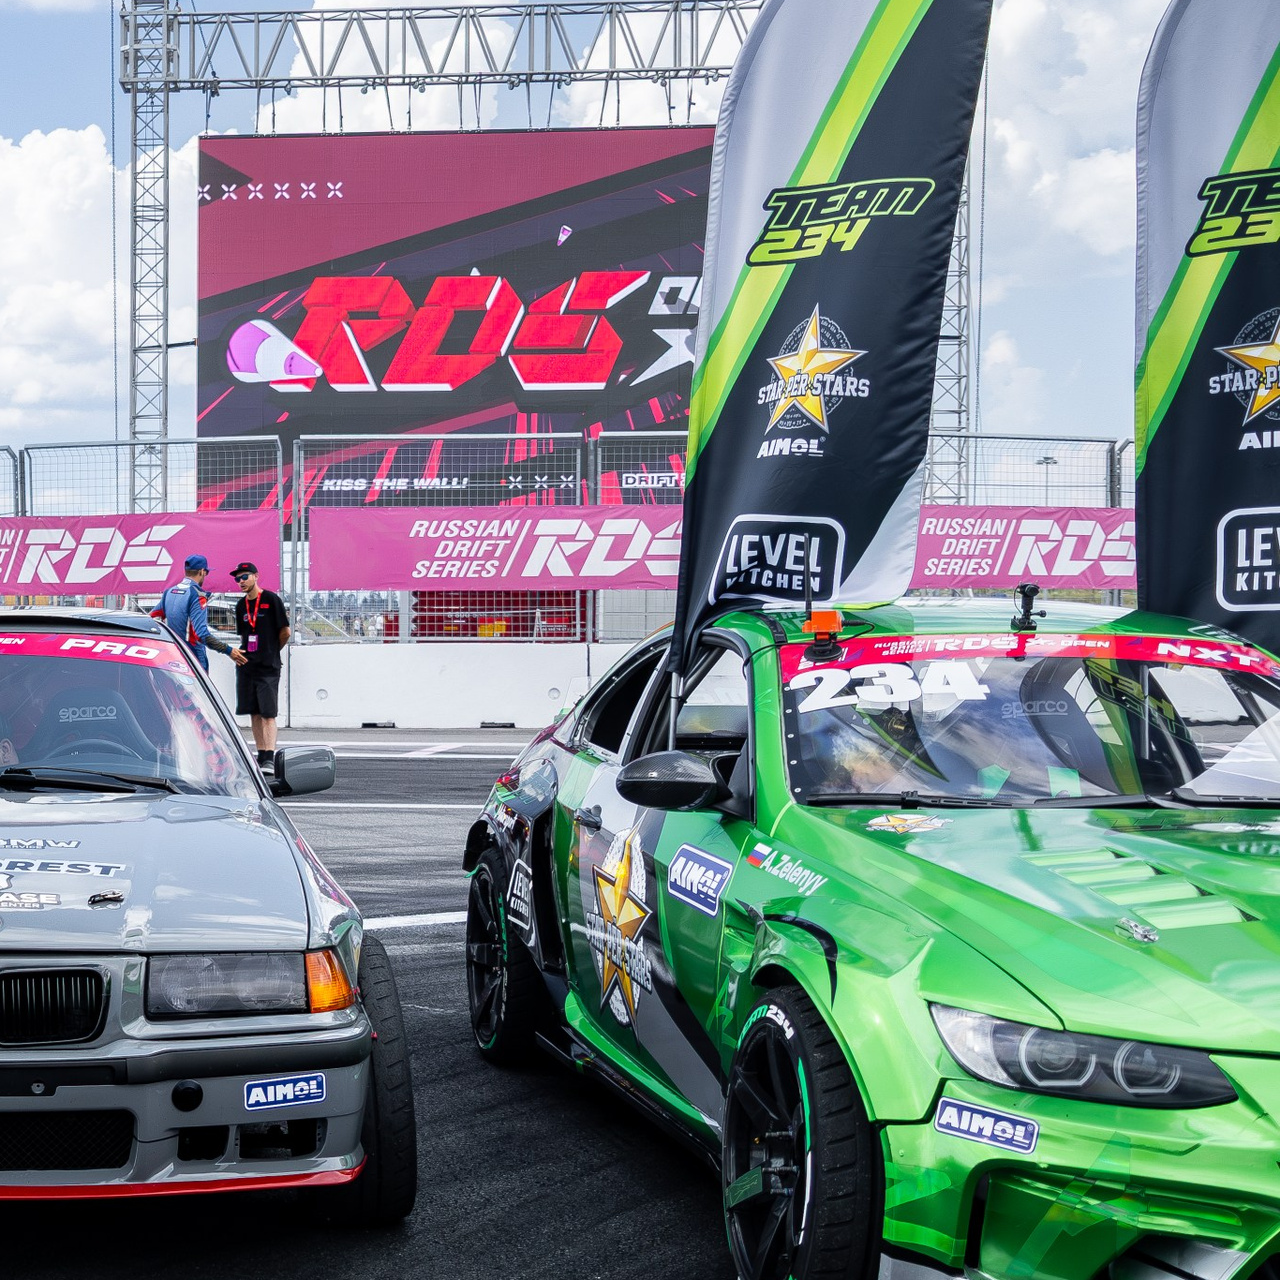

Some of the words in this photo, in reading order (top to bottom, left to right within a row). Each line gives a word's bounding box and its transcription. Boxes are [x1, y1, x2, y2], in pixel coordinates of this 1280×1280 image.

[768, 177, 936, 229] TEAM
[1202, 172, 1280, 218] TE
[749, 218, 871, 263] 234
[1189, 211, 1280, 253] 23
[269, 271, 651, 392] RDS
[812, 373, 870, 397] STARS
[1209, 368, 1260, 394] STAR
[323, 479, 367, 491] KISS
[373, 478, 409, 490] THE
[413, 477, 469, 489] WALL!
[623, 473, 678, 487] DRIFT
[409, 519, 520, 537] RUSSIAN
[921, 518, 1008, 536] RUSSIAN
[17, 524, 186, 584] RDS
[434, 539, 510, 558] DRIFT
[726, 533, 821, 573] LEVEL
[941, 538, 1001, 556] DRIFT
[1008, 520, 1136, 576] RDS
[412, 560, 499, 579] SERIES
[924, 558, 992, 576] SERIES
[60, 638, 162, 660] PRO
[933, 635, 1019, 651] RDS
[1061, 639, 1110, 648] OPEN
[1157, 642, 1261, 666] NXT
[789, 662, 991, 713] 234
[59, 704, 117, 722] sparco
[1001, 700, 1068, 717] sparco
[247, 1080, 323, 1105] AIMOL
[938, 1105, 1030, 1148] AIMOL
